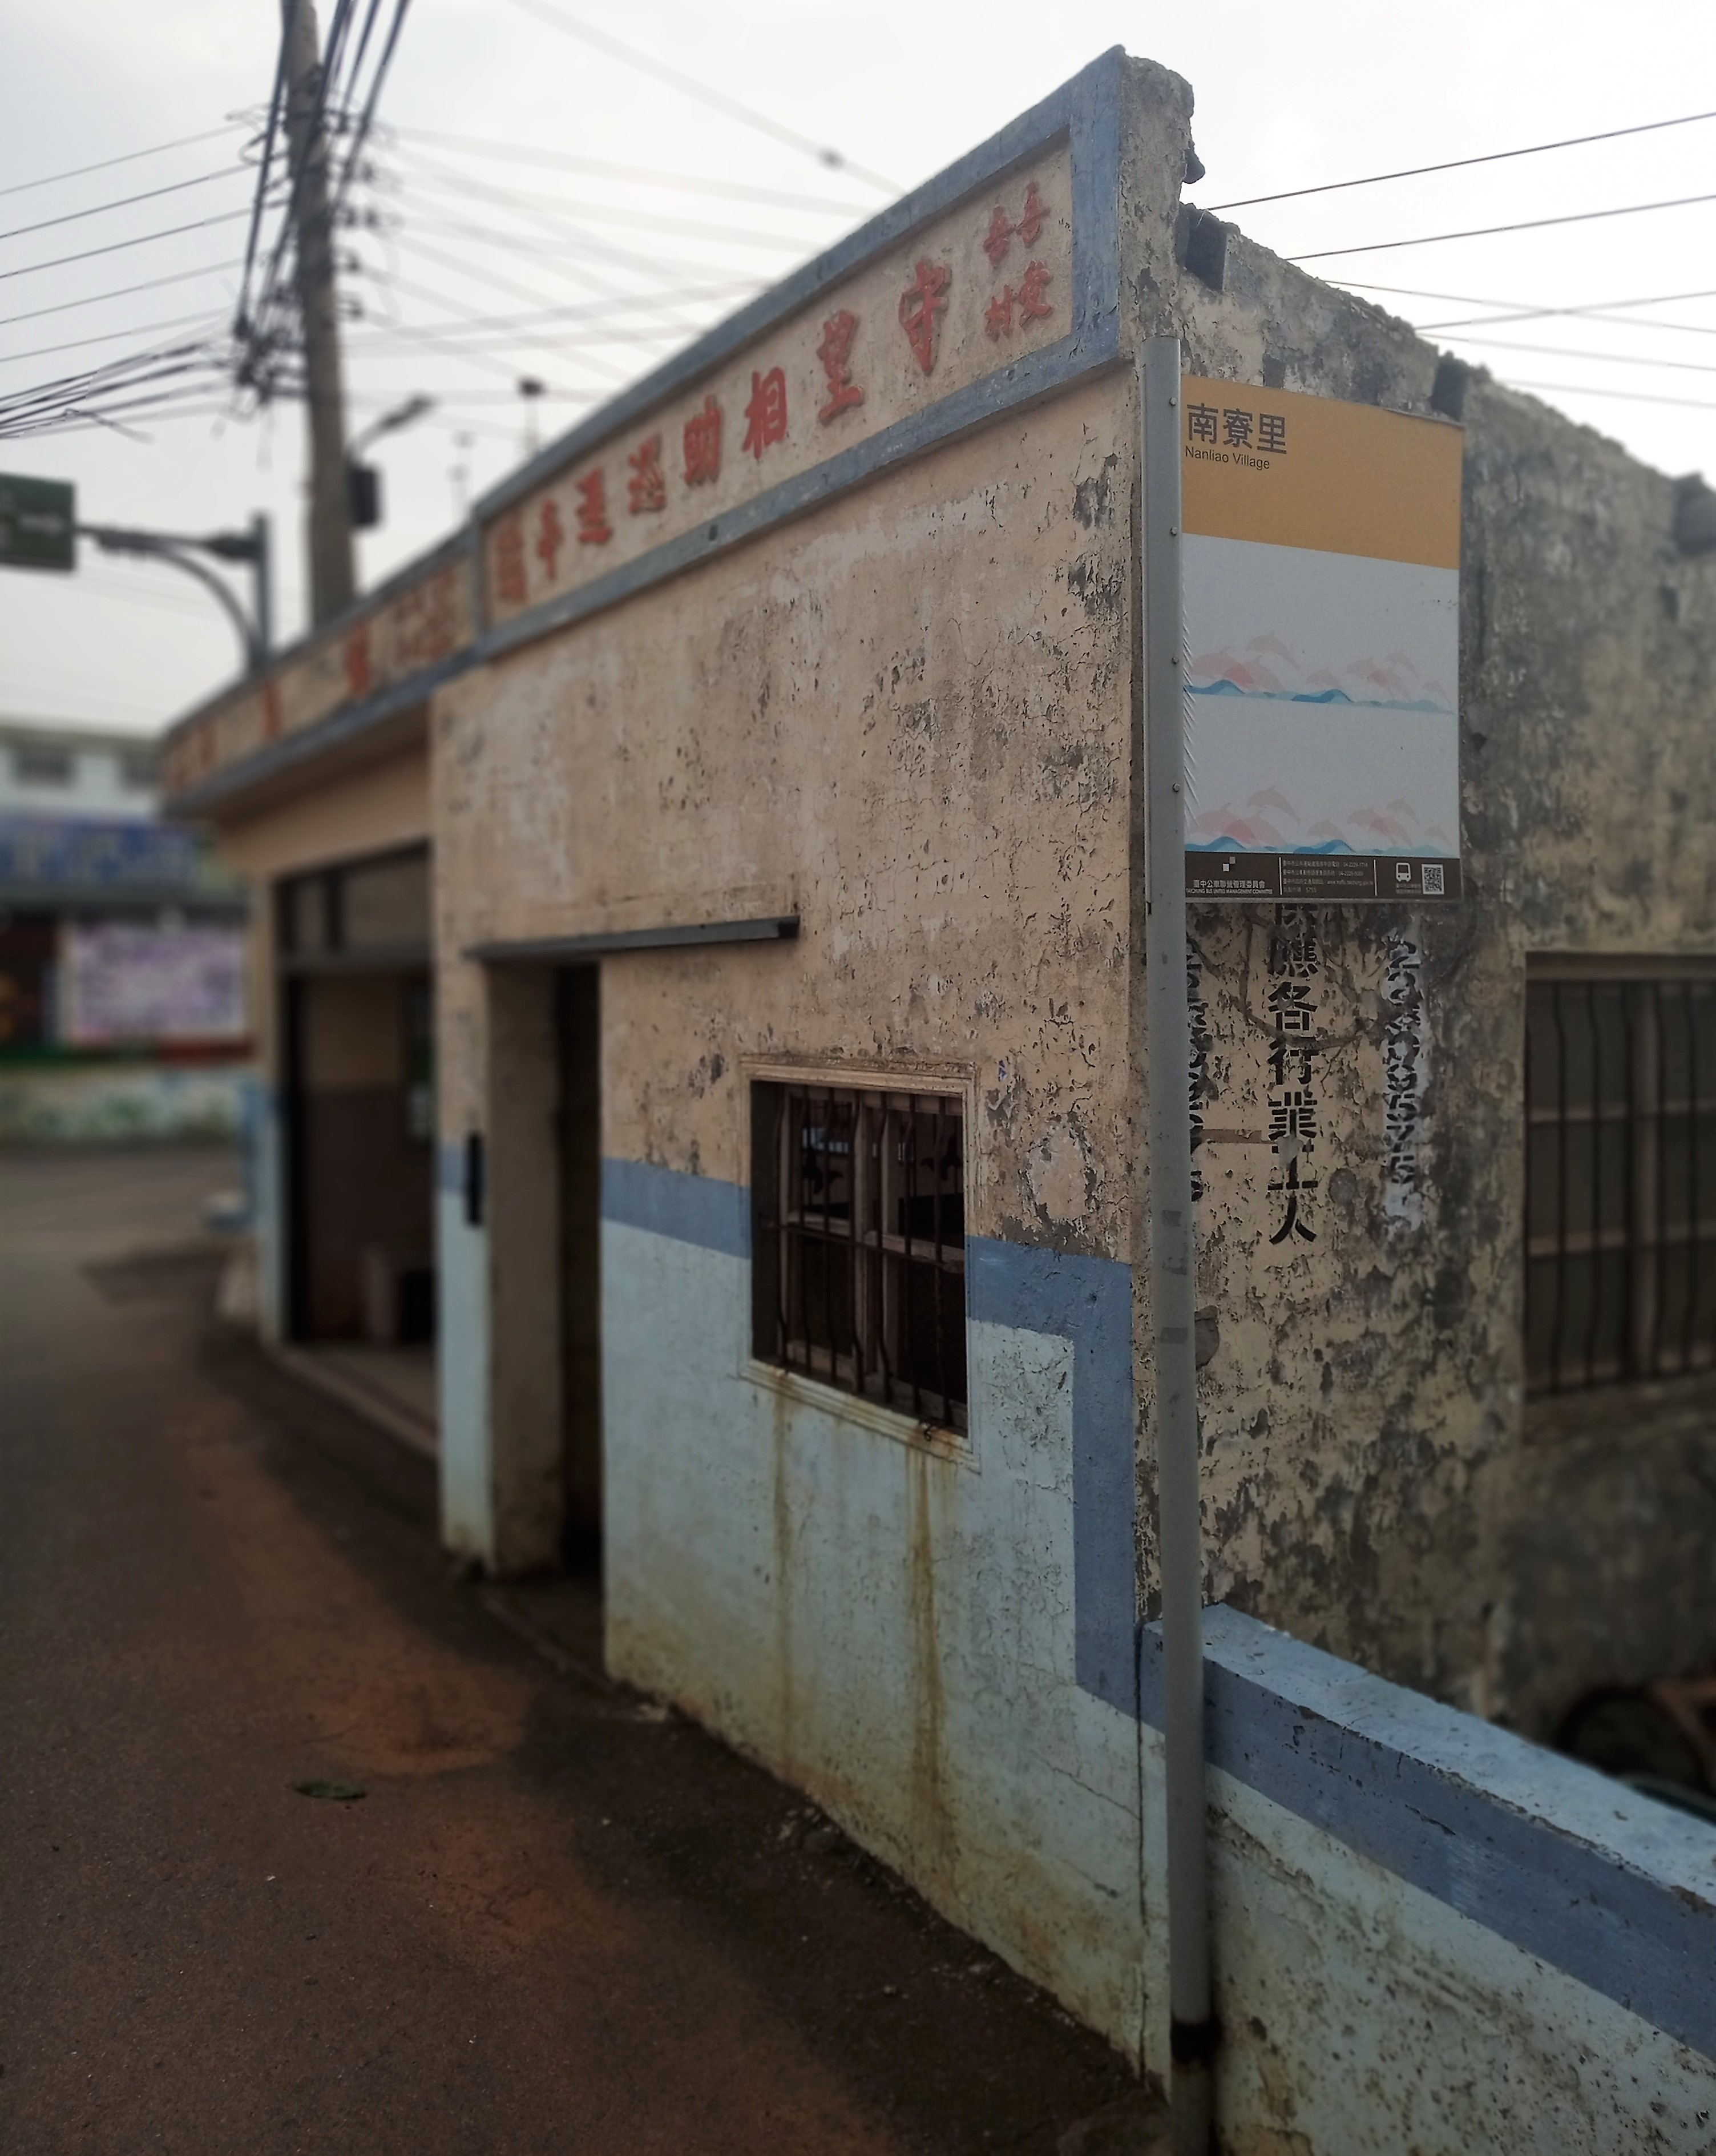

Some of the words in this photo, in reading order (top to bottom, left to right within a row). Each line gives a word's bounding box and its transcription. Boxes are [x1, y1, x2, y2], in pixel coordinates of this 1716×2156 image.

[1186, 402, 1287, 454] 南寮里
[1185, 445, 1229, 464] Nanliao
[1233, 452, 1270, 471] Village
